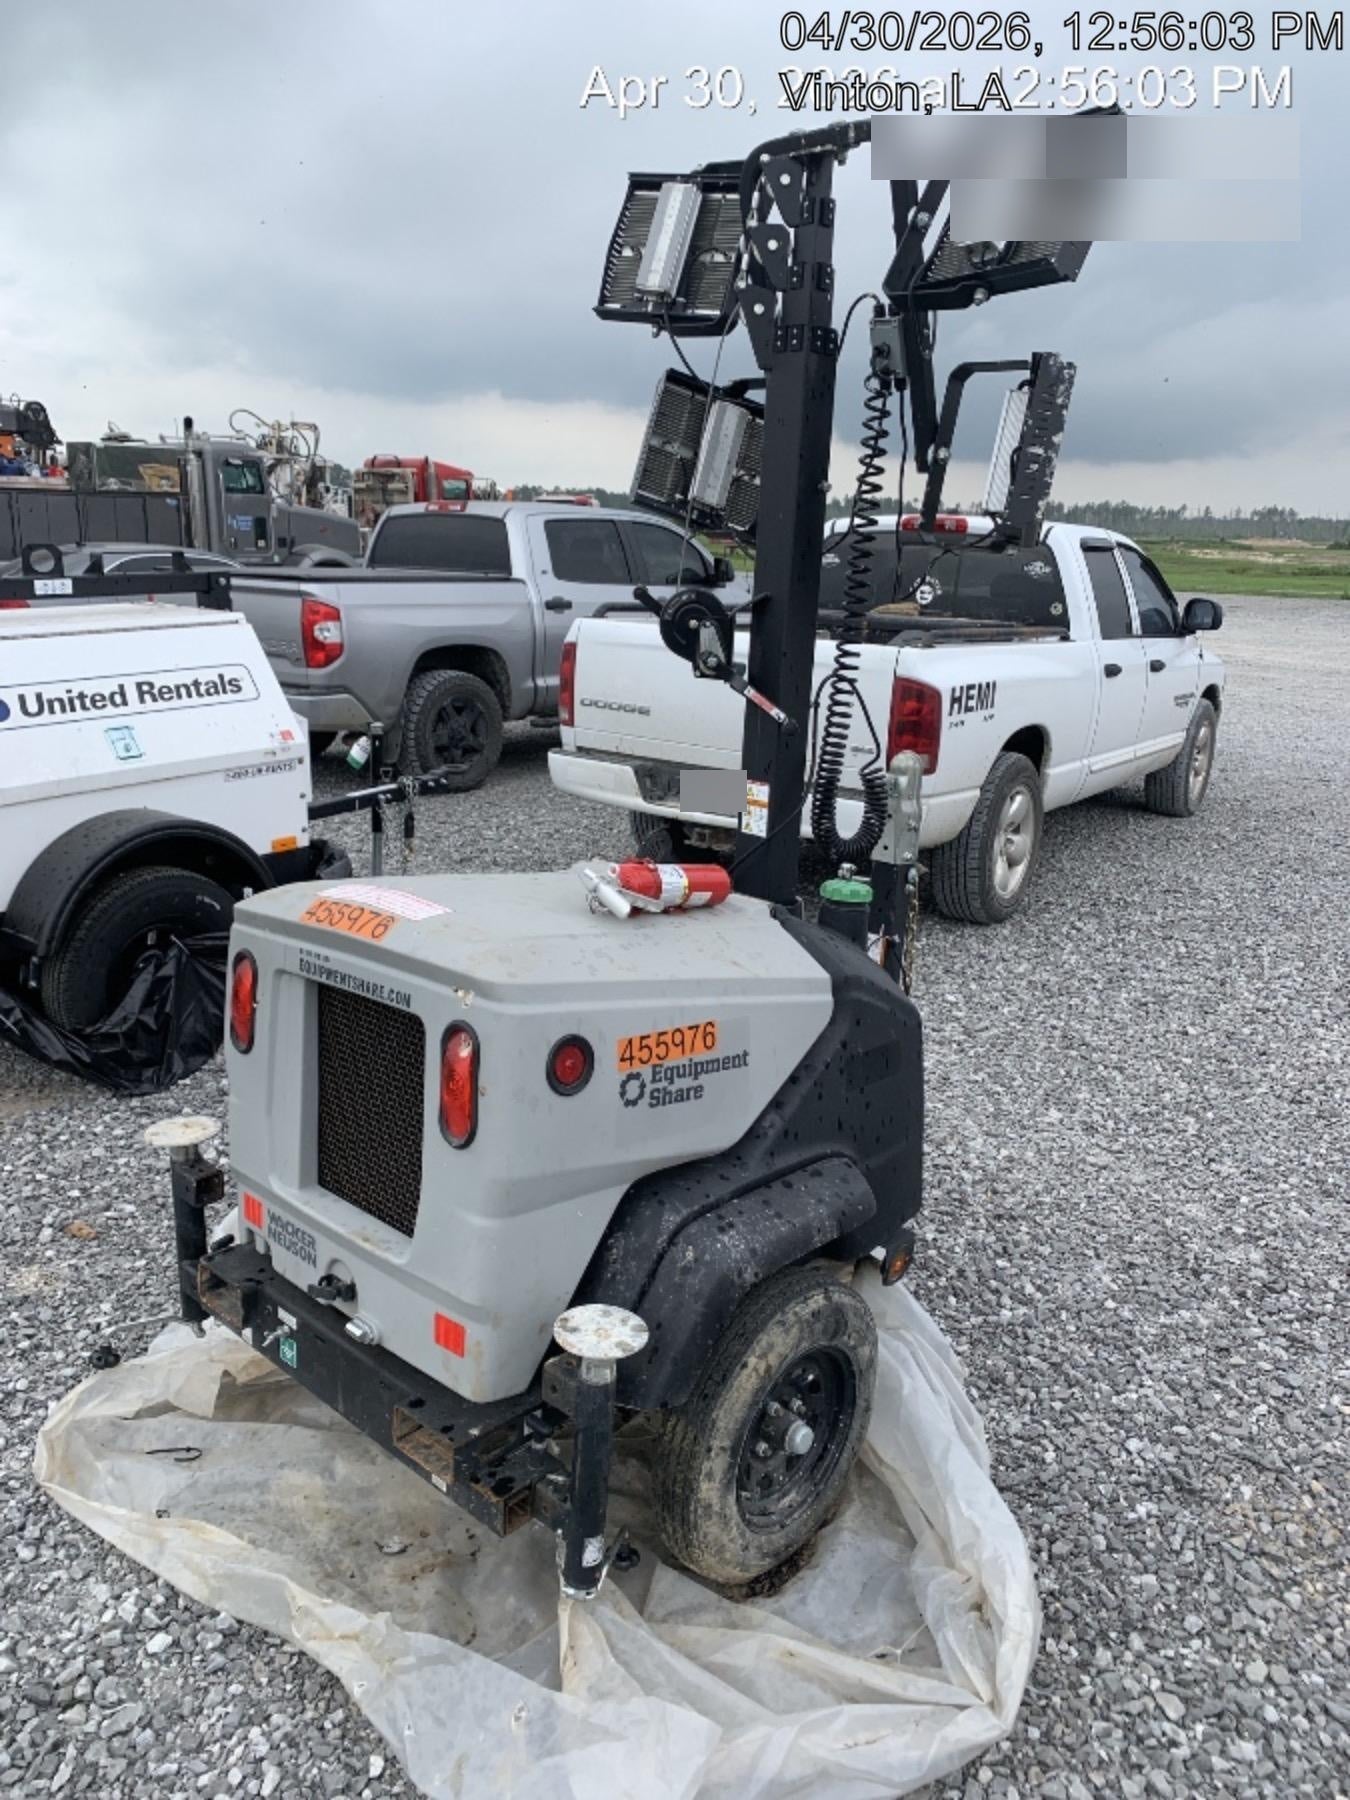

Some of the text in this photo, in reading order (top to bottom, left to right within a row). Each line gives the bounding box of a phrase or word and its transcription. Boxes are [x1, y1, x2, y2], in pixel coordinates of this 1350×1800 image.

[17, 673, 244, 718] United Rentals
[580, 697, 651, 716] DODGE
[948, 680, 997, 716] HEMI
[304, 899, 396, 940] 455976
[299, 957, 411, 1008] EQUIPMENTSHARE.COM
[618, 1020, 717, 1068] 455976
[650, 1049, 750, 1085] Equipment
[648, 1083, 705, 1109] Share
